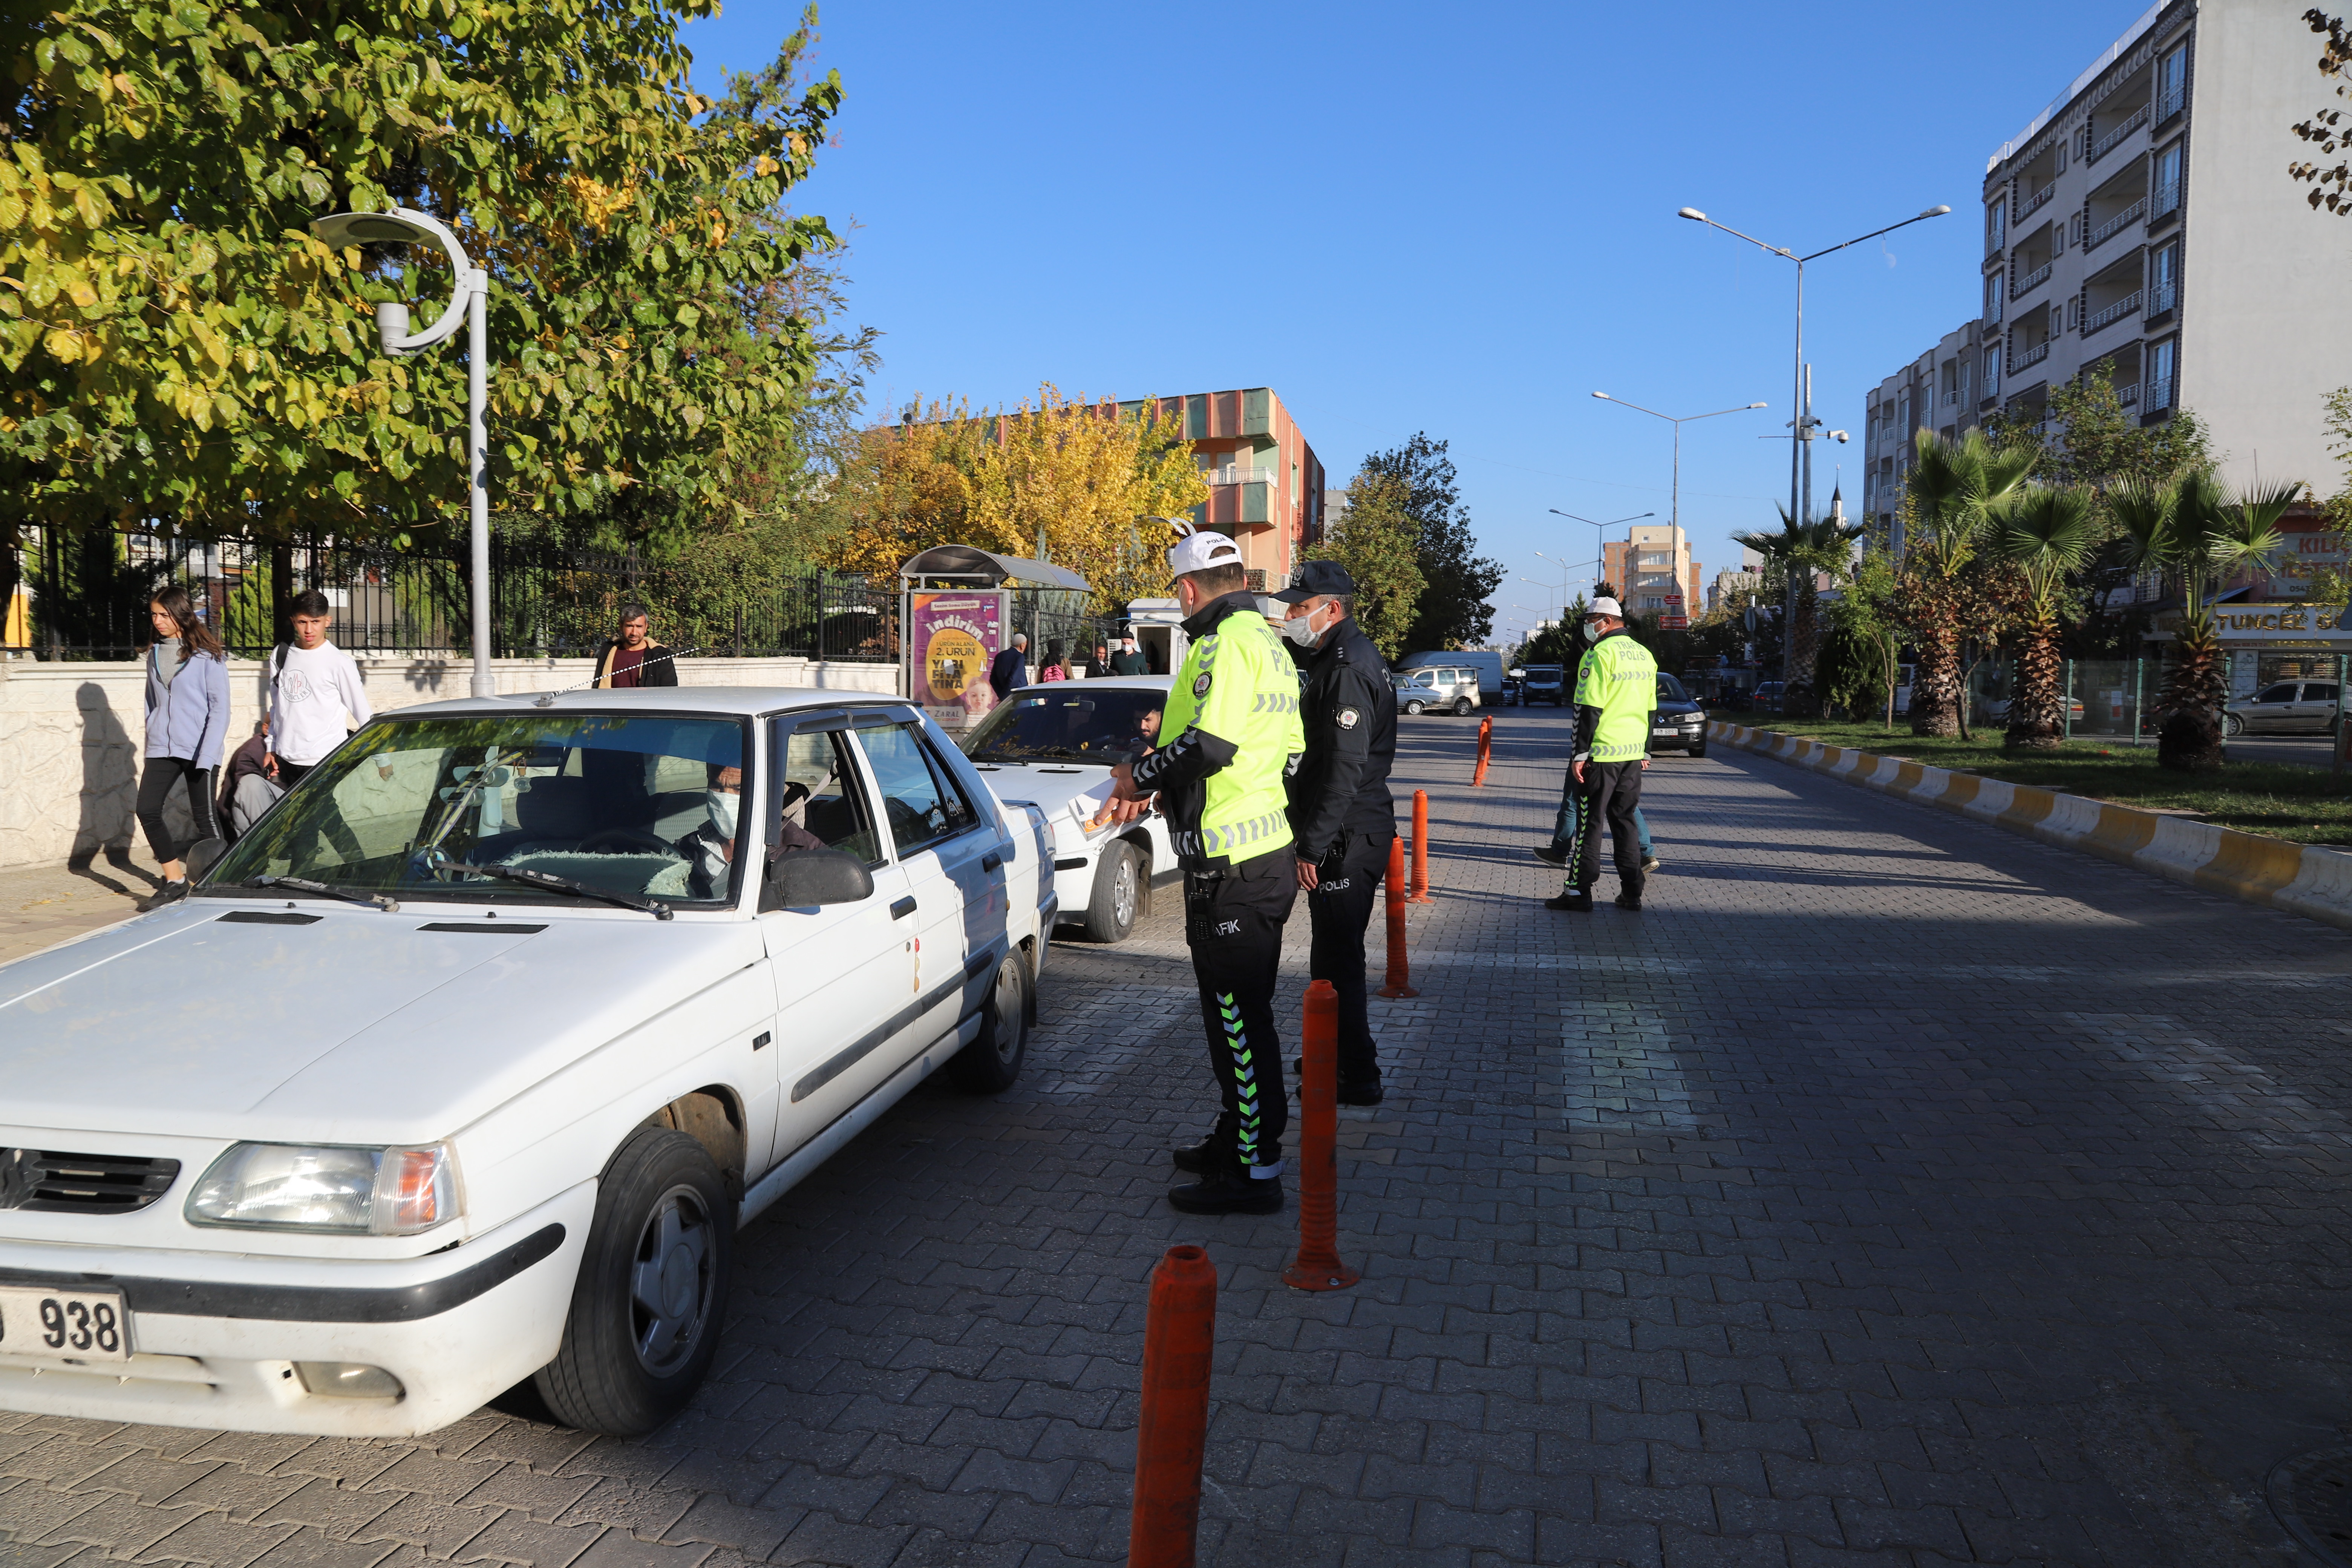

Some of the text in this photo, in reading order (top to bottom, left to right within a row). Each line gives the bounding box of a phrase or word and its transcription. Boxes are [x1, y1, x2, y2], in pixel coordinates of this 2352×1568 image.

[2216, 614, 2307, 630] TUNCEL
[946, 647, 975, 655] ÜRÜN
[40, 1298, 119, 1352] 938
